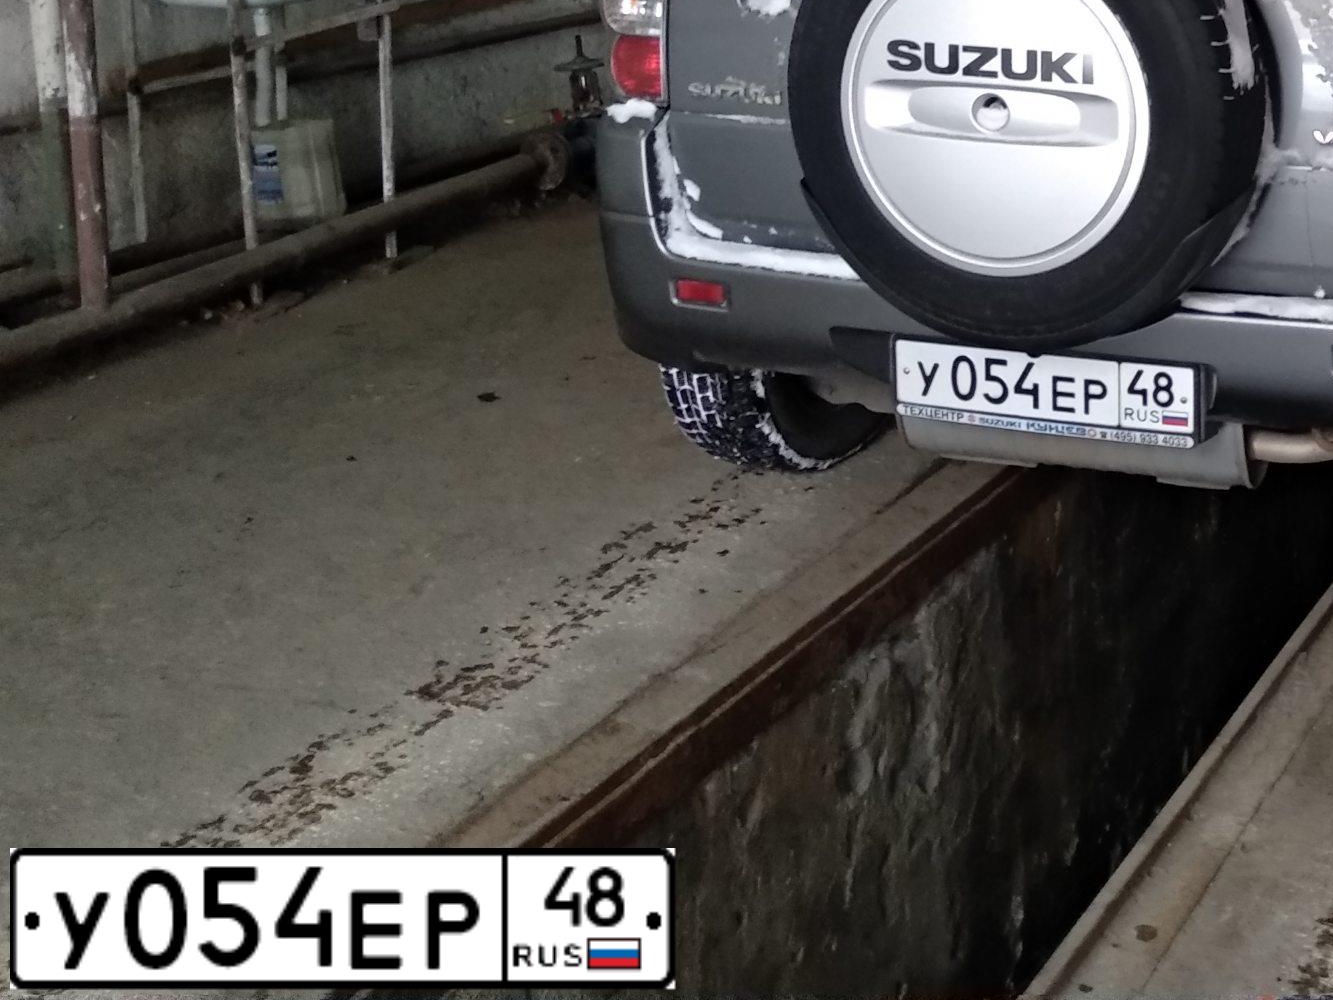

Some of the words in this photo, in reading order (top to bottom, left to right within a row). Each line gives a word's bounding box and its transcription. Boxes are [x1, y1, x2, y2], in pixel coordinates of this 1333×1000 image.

[886, 39, 1094, 85] SUZUKI
[1127, 369, 1175, 409] 48
[902, 404, 965, 421] ТЕХЦЕНТР
[978, 417, 1022, 429] SUZUKI
[1123, 408, 1161, 425] RUS
